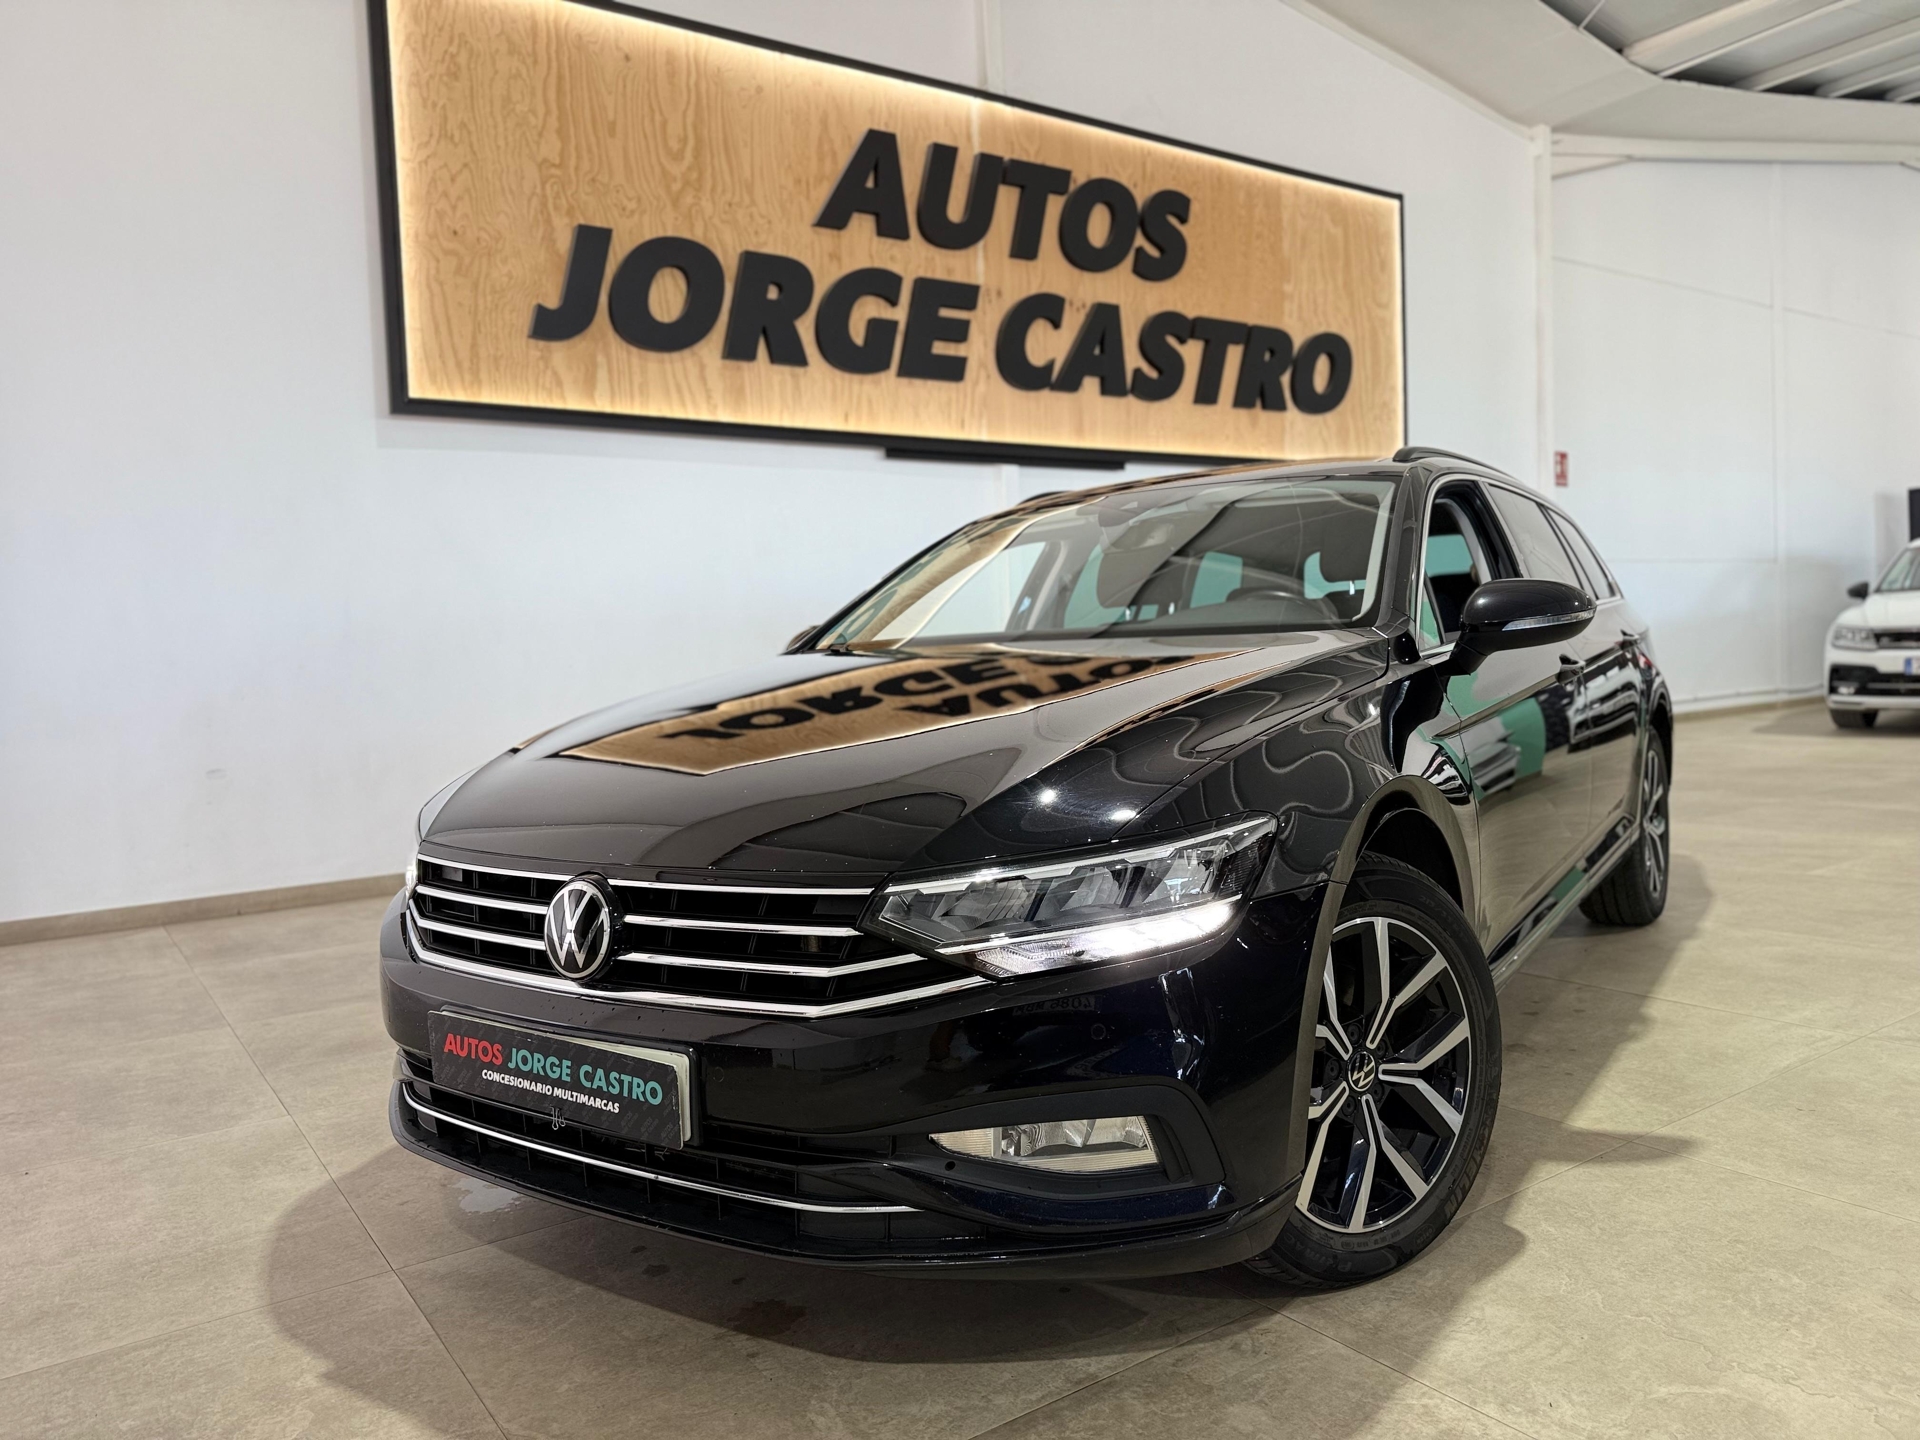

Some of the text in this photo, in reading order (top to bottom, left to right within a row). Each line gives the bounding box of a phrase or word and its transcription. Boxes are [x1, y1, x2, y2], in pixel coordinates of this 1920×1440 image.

[812, 128, 1191, 281] AUTOS
[528, 223, 1352, 415] JORGE CASTRO
[444, 1033, 503, 1065] AUTOS
[507, 1047, 571, 1083] JORGE
[578, 1064, 663, 1106] CASTRO
[481, 1069, 620, 1114] CONCESIONARIO MULTIMARCAS
